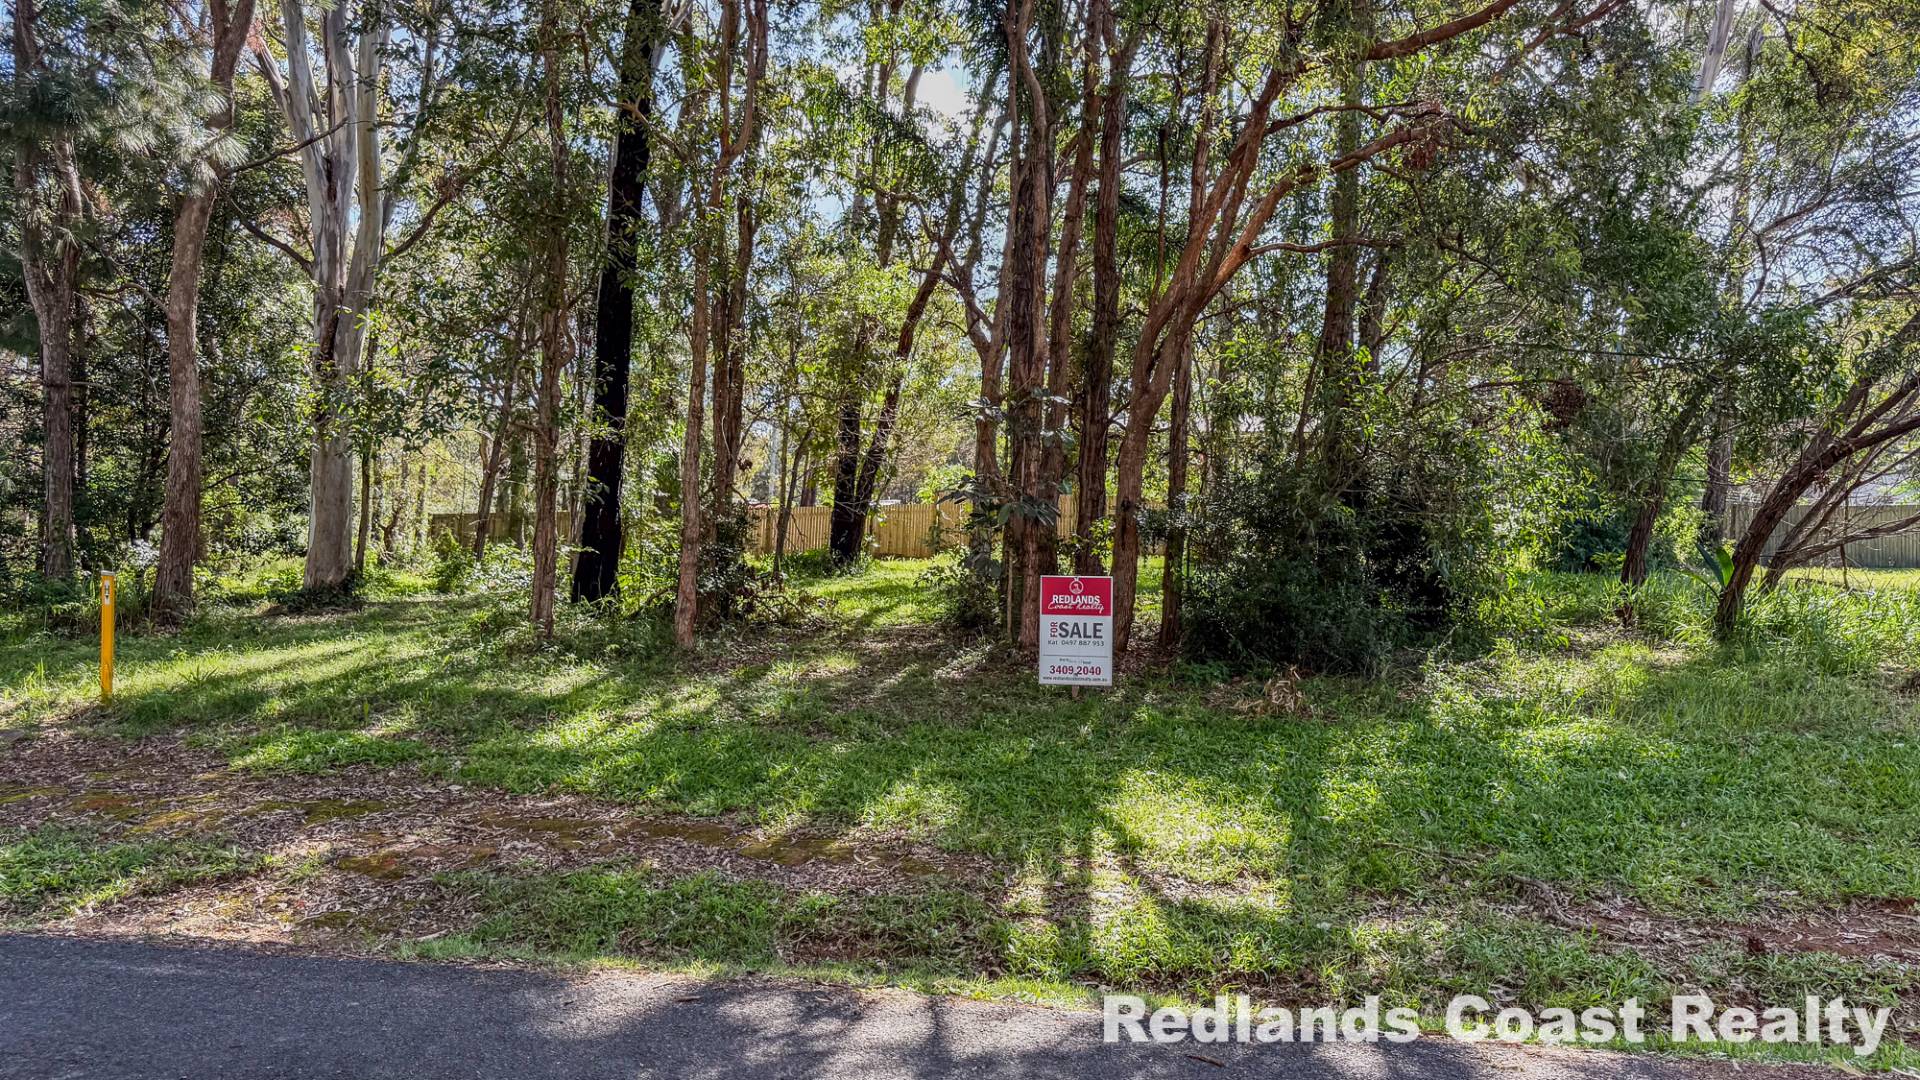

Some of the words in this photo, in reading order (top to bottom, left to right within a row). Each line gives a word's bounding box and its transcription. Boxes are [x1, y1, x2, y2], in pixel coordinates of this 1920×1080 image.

[1052, 594, 1101, 604] REDLANDS
[1047, 602, 1073, 610] Coast
[1076, 603, 1104, 614] Realty
[1049, 621, 1058, 638] FOR
[1058, 621, 1104, 639] SALE
